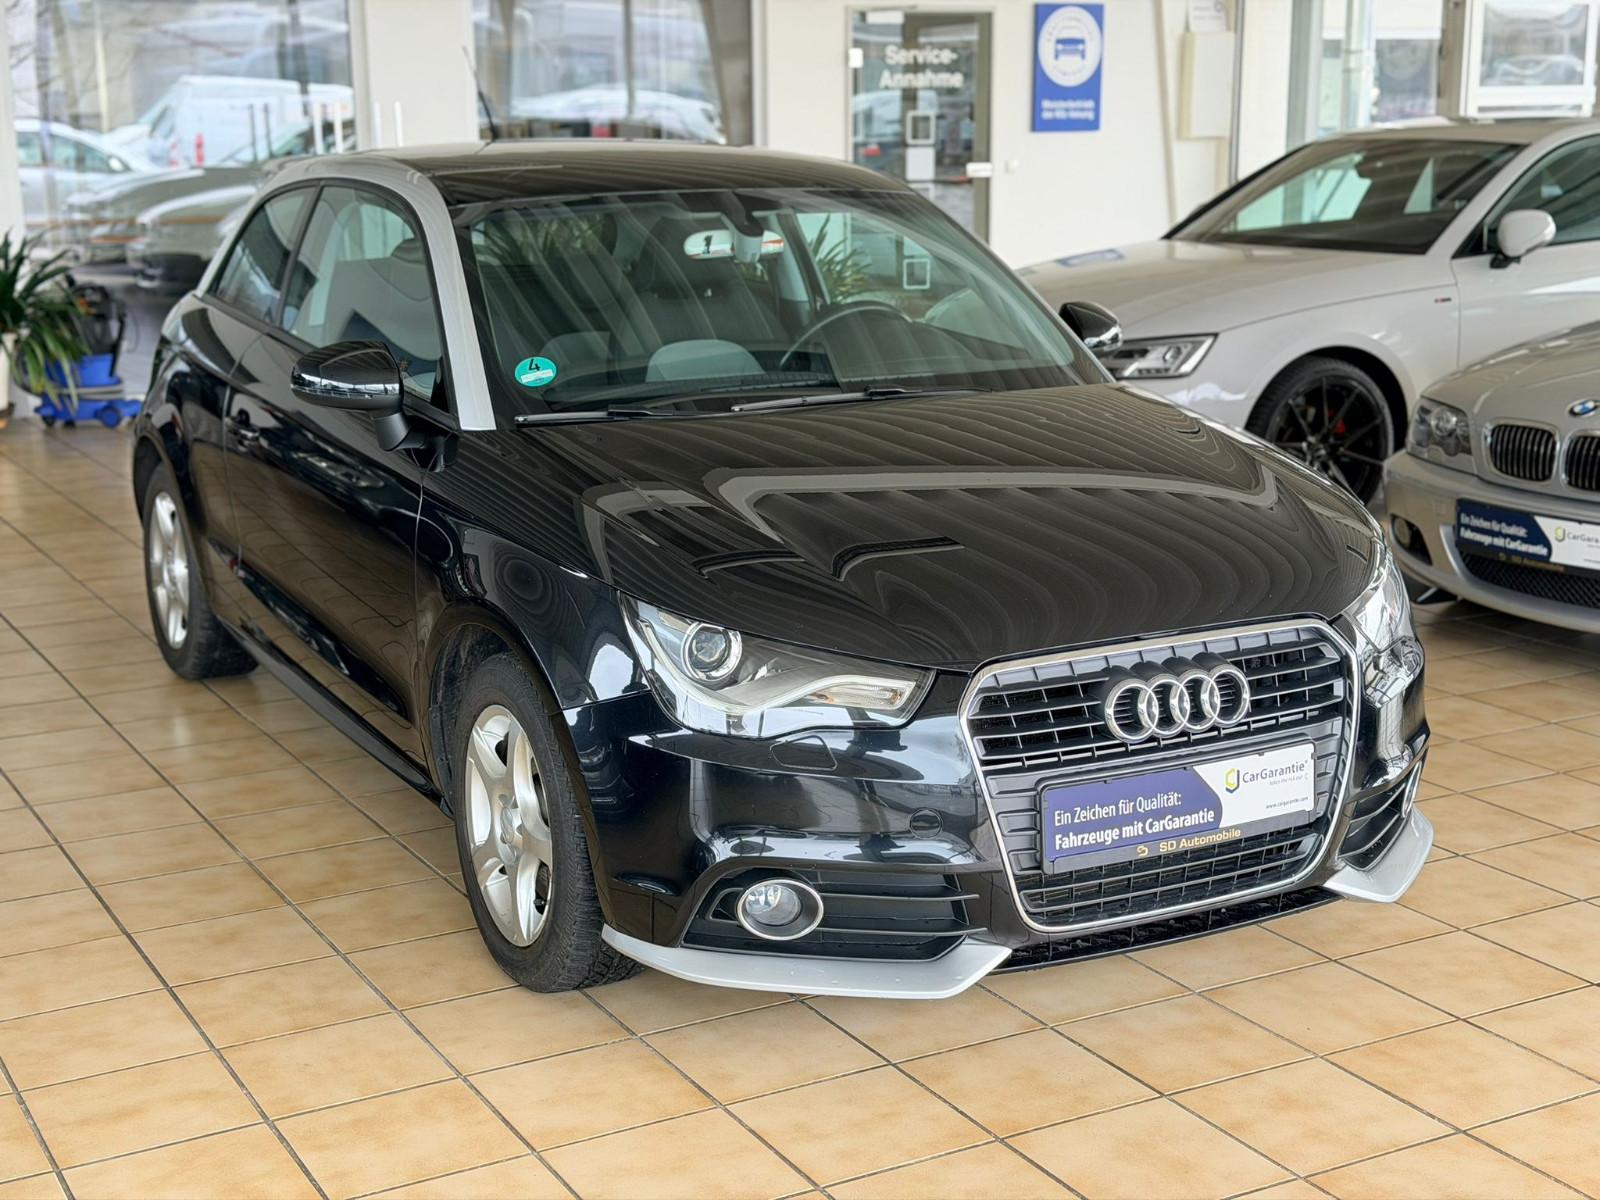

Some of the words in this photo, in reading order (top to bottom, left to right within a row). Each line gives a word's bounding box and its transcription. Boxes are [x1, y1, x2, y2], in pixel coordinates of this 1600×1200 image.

[884, 44, 958, 65] Service-
[879, 69, 964, 89] Annahme
[529, 358, 541, 371] 4
[1242, 761, 1305, 783] CarGarantie
[1054, 810, 1072, 826] Ein
[1074, 803, 1116, 823] Zeichen
[1118, 799, 1135, 815] für
[1136, 792, 1182, 813] Qualität:
[1055, 829, 1119, 850] Fahrzeuge
[1122, 821, 1144, 838] mit
[1145, 808, 1215, 834] CarGarantie
[1159, 840, 1177, 852] SD
[1180, 828, 1241, 848] Automobile
